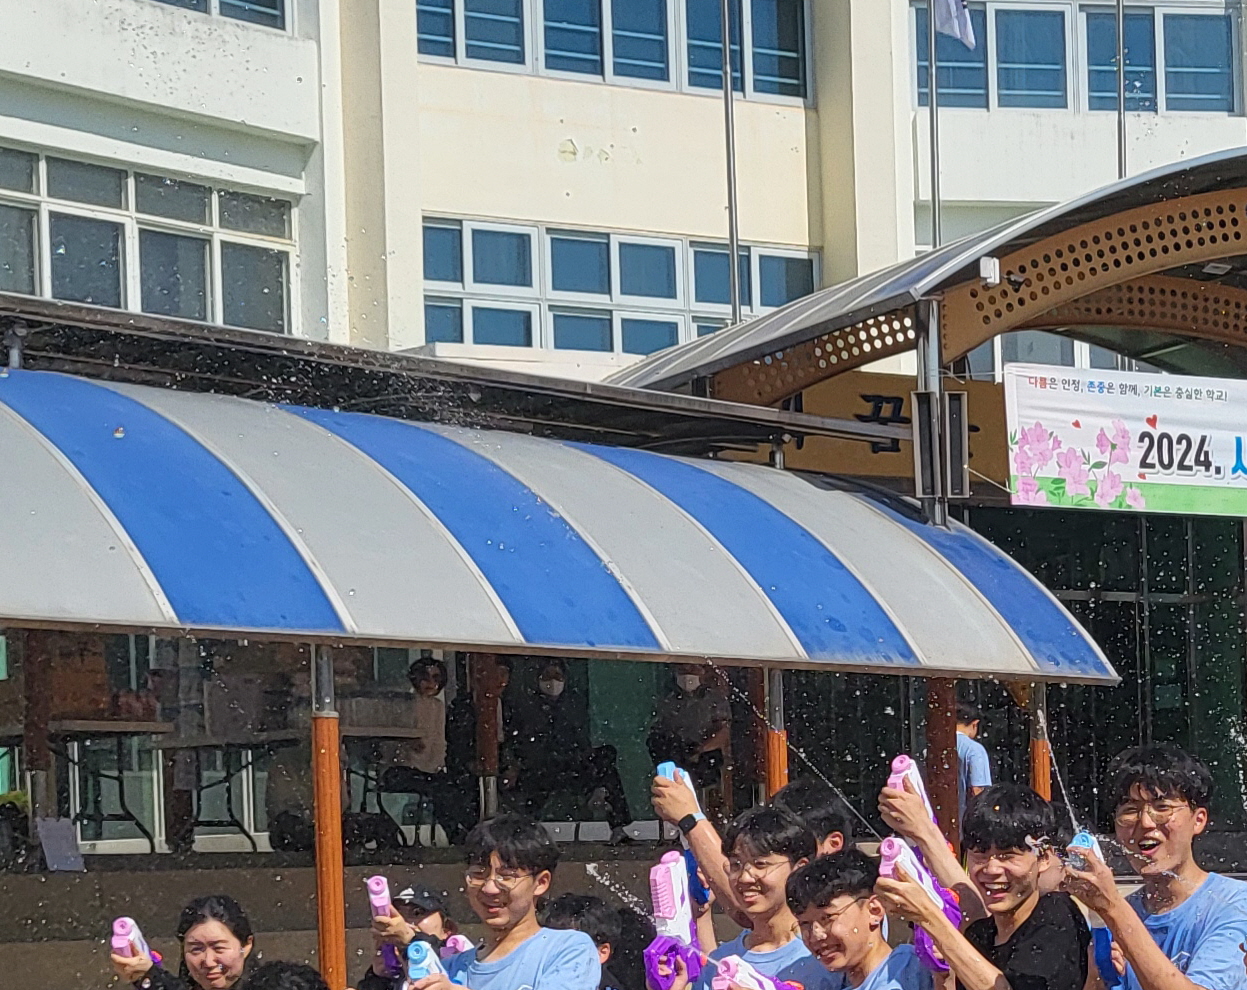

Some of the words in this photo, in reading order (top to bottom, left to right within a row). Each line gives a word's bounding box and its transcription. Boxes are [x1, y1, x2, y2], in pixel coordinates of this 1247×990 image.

[1028, 376, 1059, 391] 다름은
[1061, 377, 1084, 393] 인정,
[1086, 380, 1116, 394] 존중은
[1118, 383, 1141, 398] 함께,
[1143, 385, 1173, 399] 기본은
[1205, 389, 1228, 402] 학교!
[1138, 431, 1222, 475] 2024.
